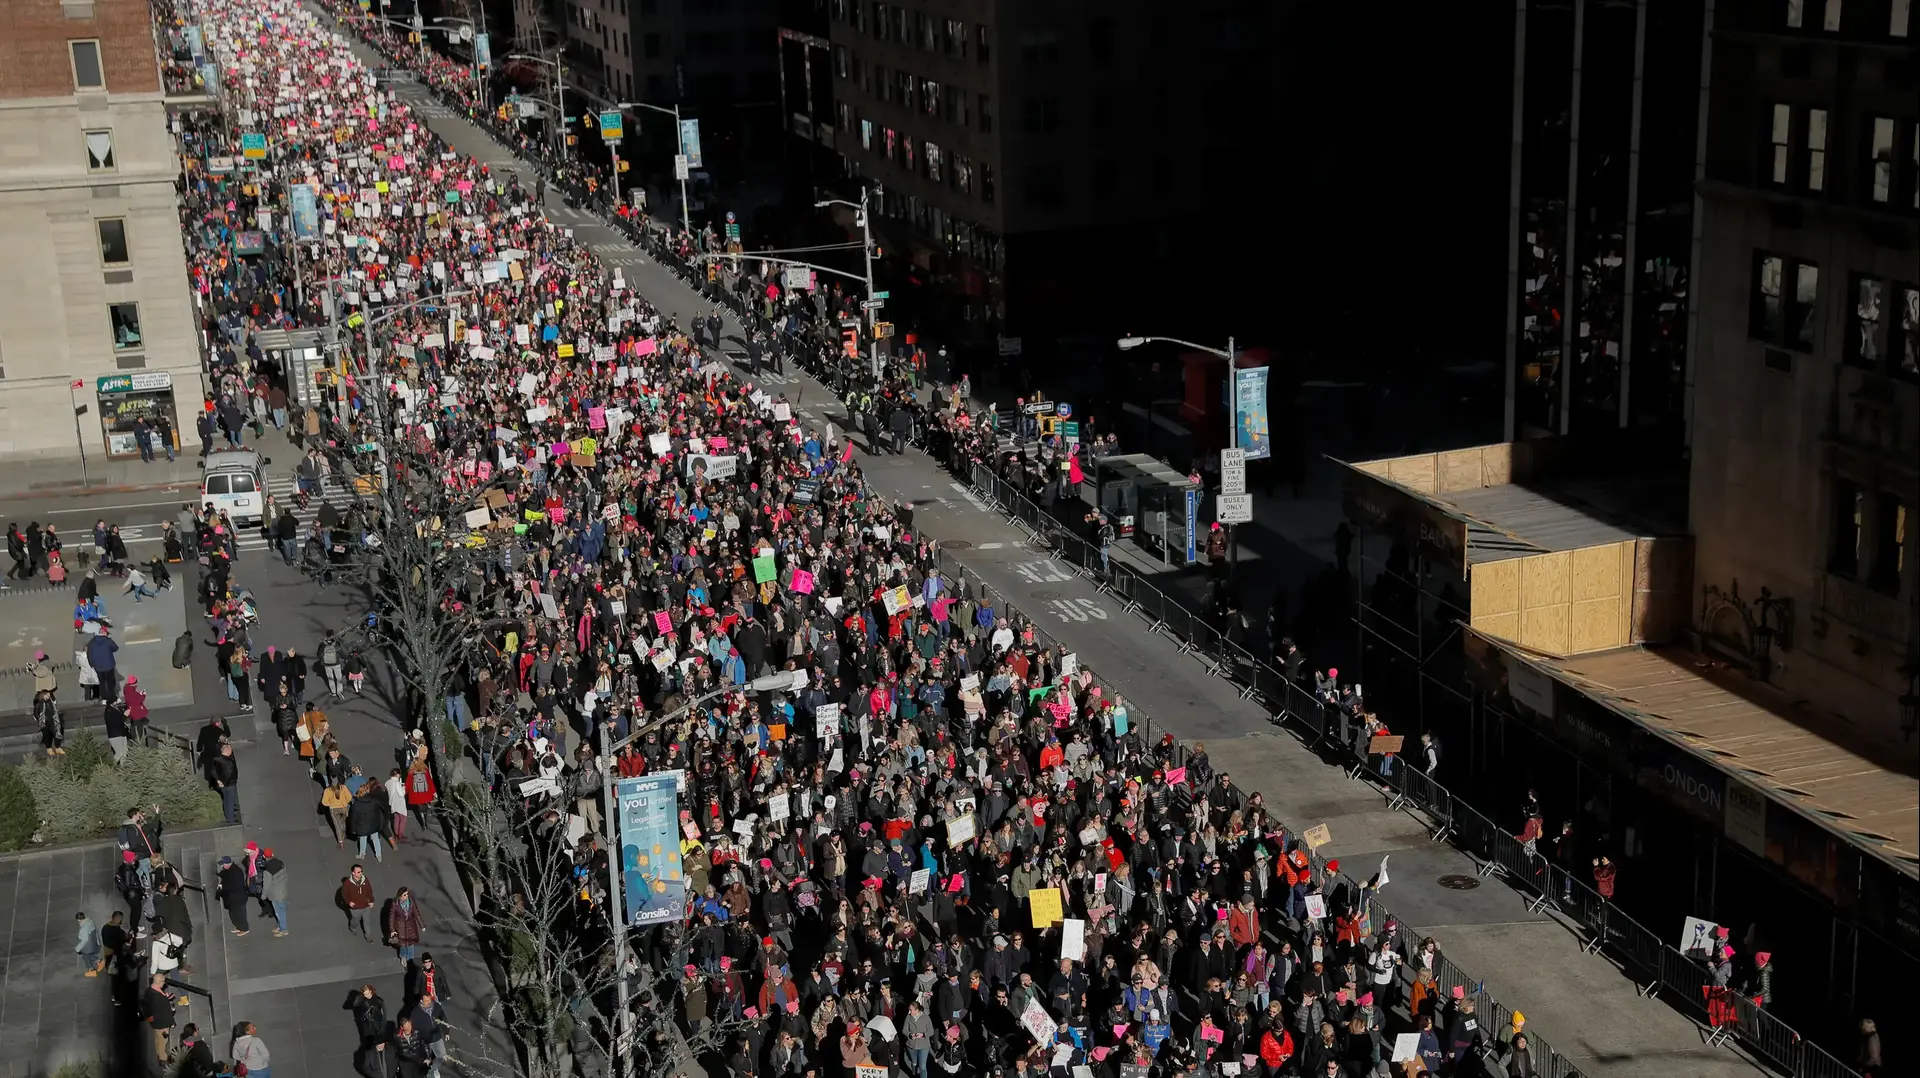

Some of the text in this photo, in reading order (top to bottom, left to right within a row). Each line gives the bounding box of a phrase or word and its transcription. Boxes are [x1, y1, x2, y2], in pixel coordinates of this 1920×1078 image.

[636, 781, 659, 792] NYC
[1660, 763, 1721, 813] ONDON
[624, 797, 647, 812] you
[635, 907, 669, 920] Consilio
